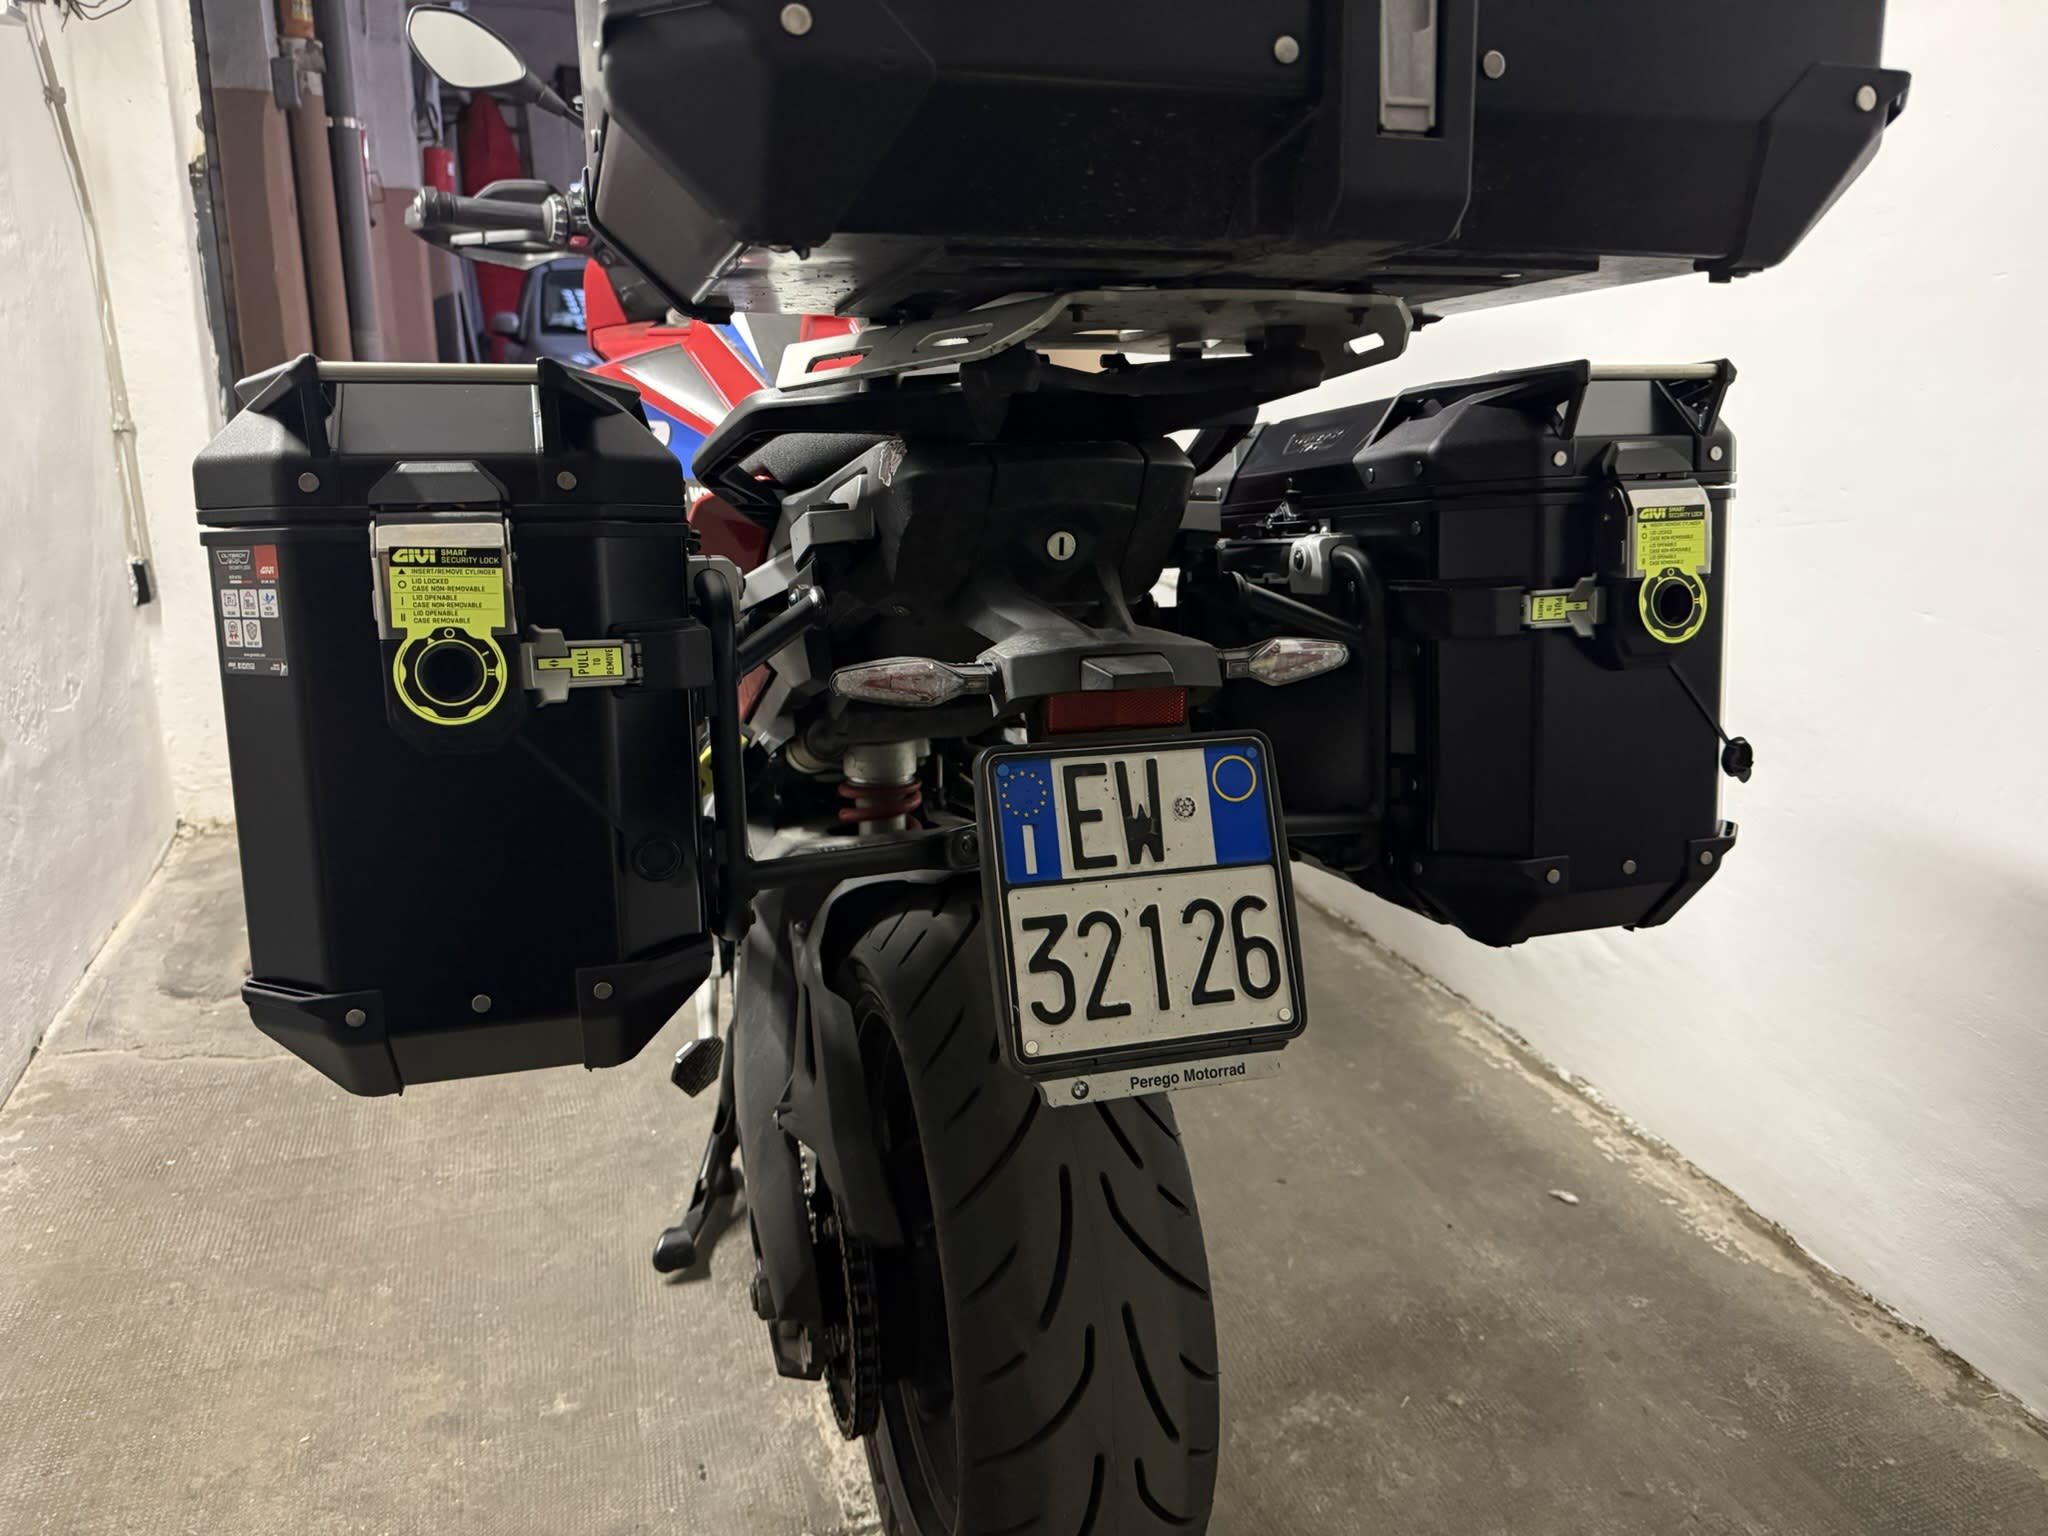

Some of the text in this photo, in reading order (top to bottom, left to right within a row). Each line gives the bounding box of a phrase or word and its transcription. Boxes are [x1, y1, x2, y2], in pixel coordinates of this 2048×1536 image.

[1639, 508, 1666, 519] GIVI
[392, 549, 436, 563] GIVI
[576, 650, 590, 675] PULL
[593, 658, 601, 666] TO
[605, 648, 614, 675] REMOVE
[1062, 758, 1165, 870] EW
[1021, 895, 1281, 1026] 32126
[1130, 1062, 1246, 1089] Perego Motorrad
